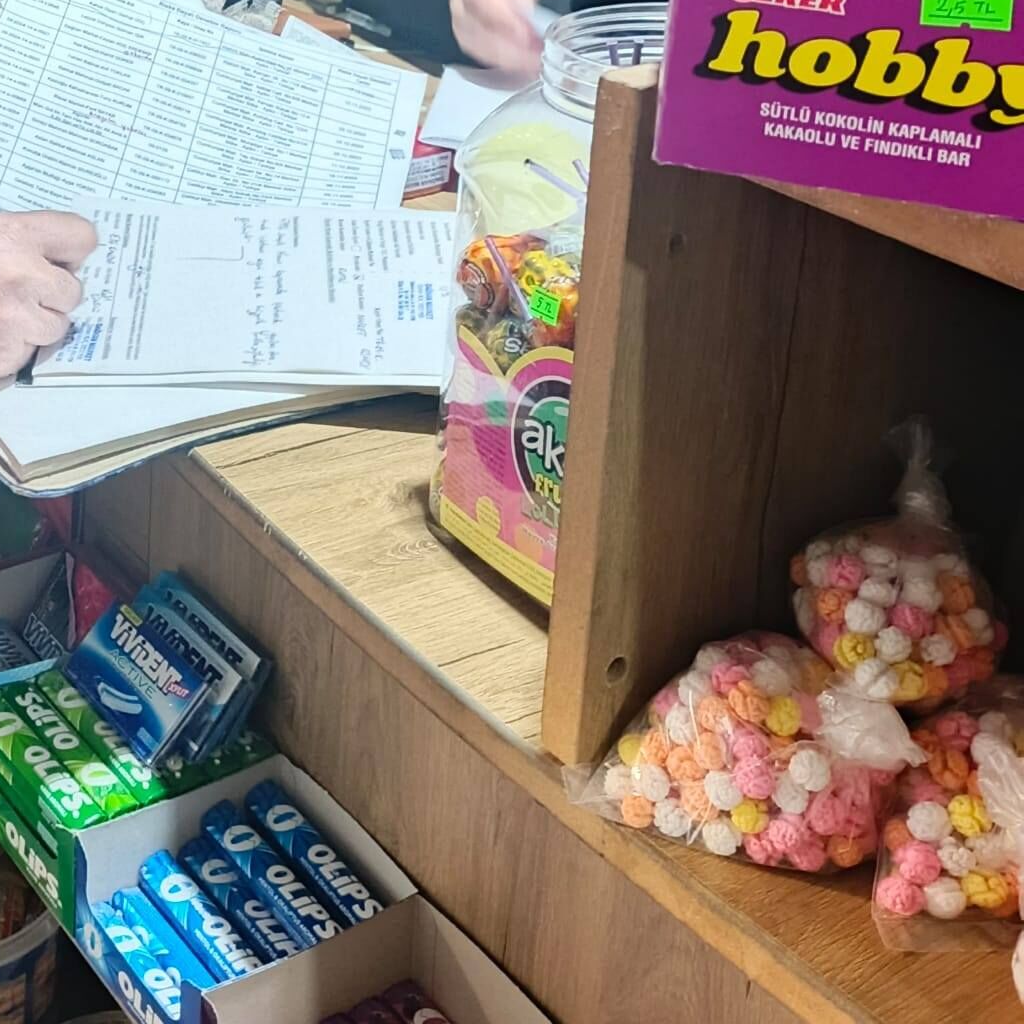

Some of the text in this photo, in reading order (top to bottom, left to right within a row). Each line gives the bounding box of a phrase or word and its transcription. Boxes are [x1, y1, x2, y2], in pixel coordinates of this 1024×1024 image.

[708, 10, 1024, 125] hobby
[760, 102, 981, 150] SÜTLÜ KOKOLİN KAPLAMALI
[764, 122, 970, 167] KAKAOLU VE FINDIKLI BAR
[108, 648, 157, 700] ACTIVE
